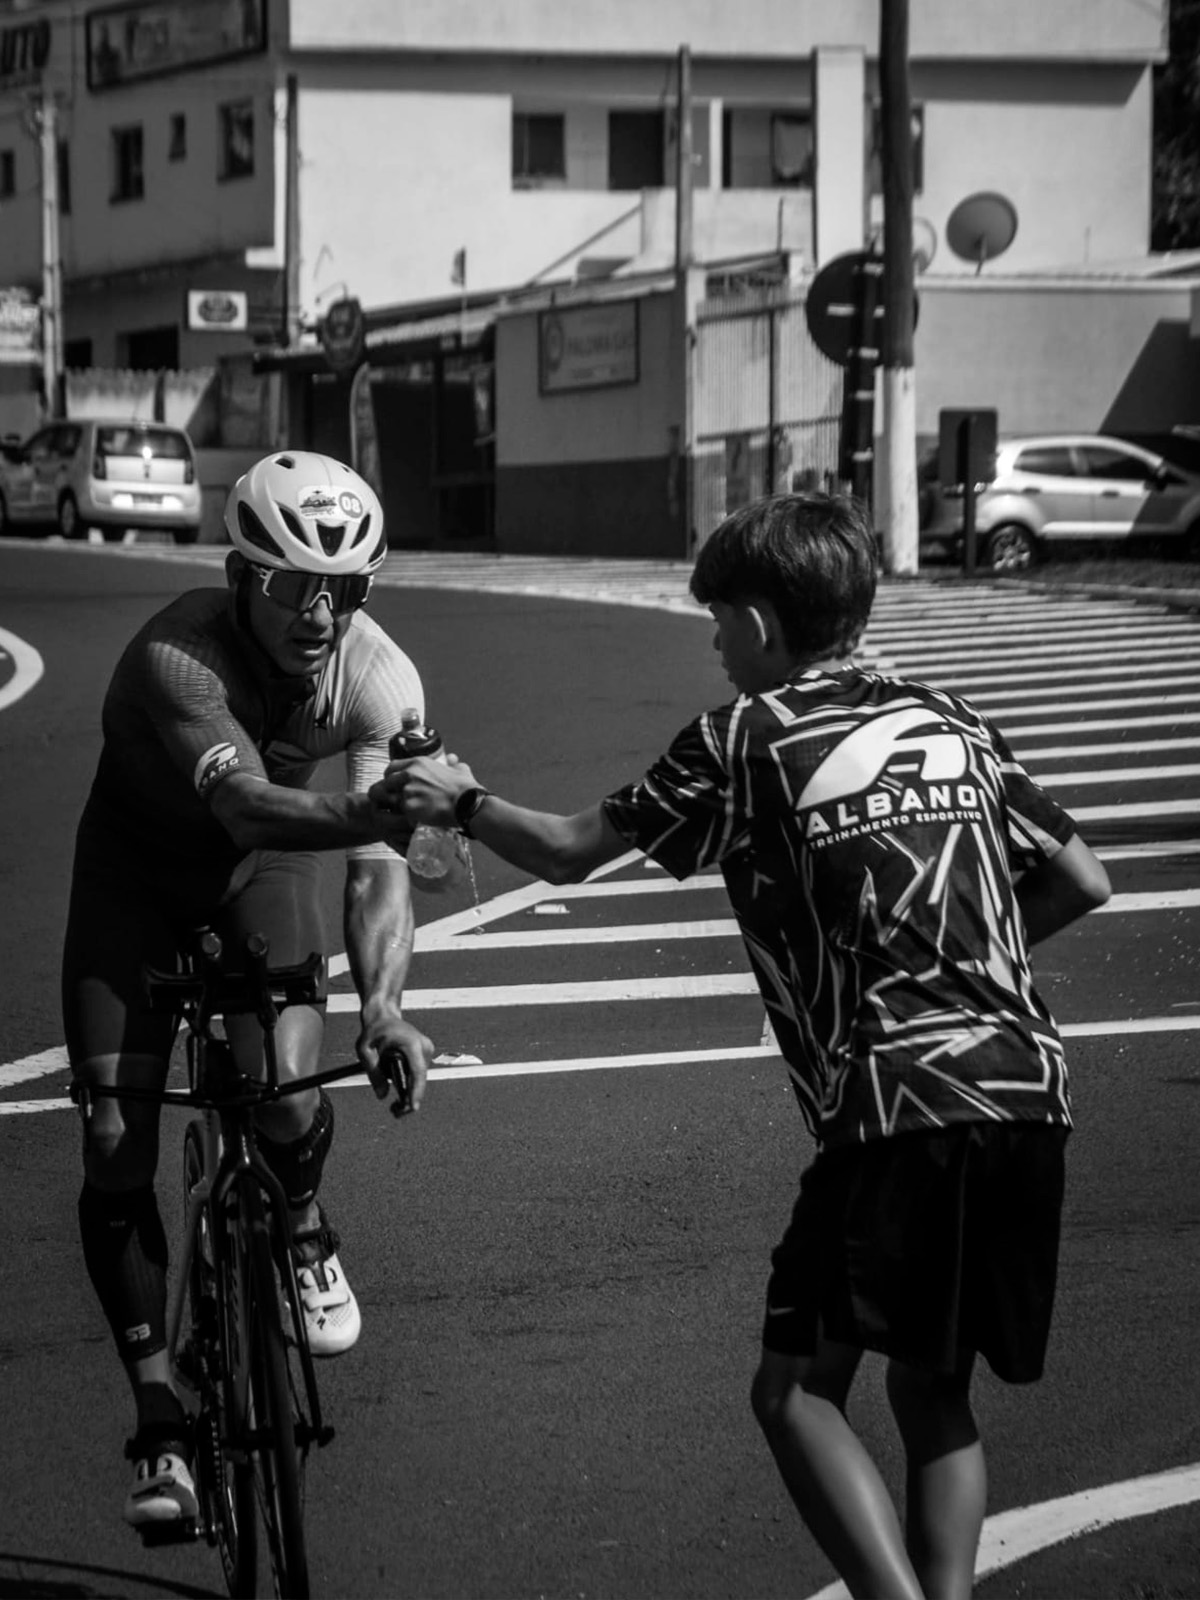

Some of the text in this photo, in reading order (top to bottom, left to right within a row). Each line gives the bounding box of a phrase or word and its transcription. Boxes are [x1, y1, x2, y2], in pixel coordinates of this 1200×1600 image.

[341, 495, 361, 514] 08
[806, 785, 978, 839] ALBANO
[809, 810, 982, 850] TREINAMENTO ESPORTIVO
